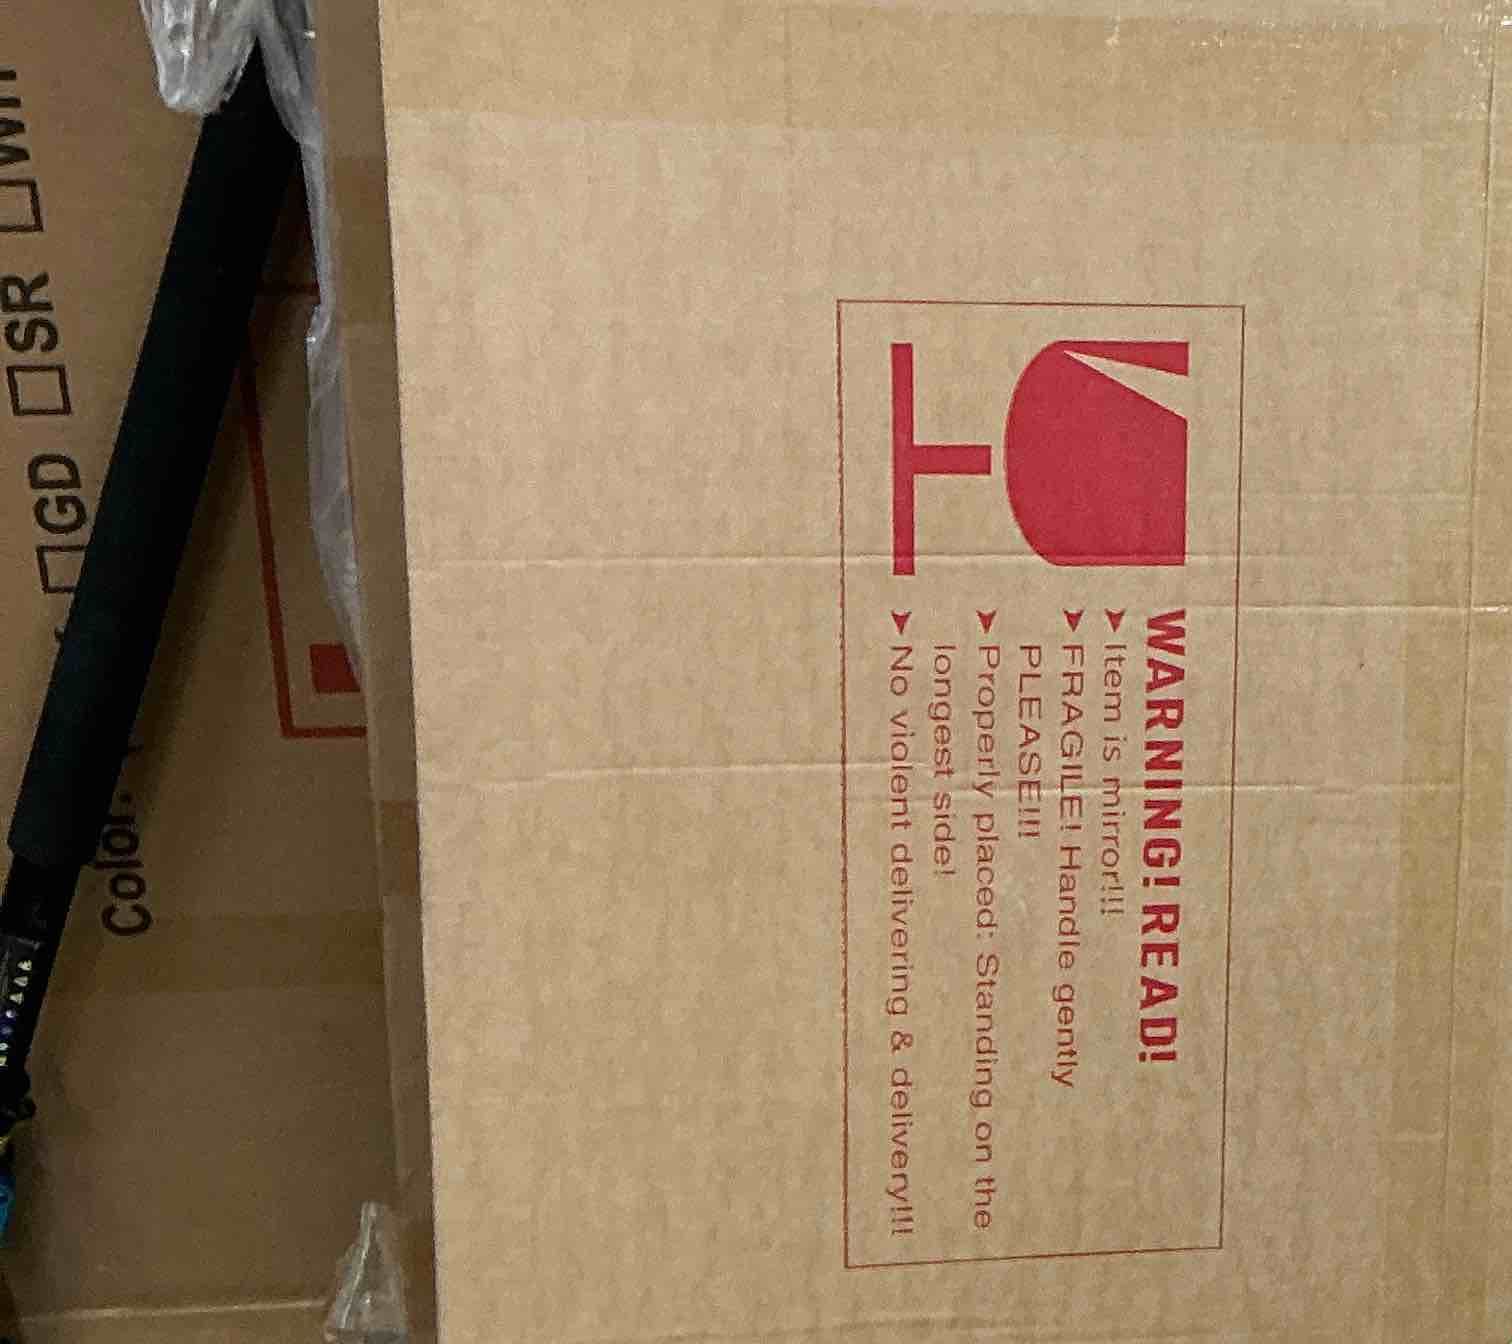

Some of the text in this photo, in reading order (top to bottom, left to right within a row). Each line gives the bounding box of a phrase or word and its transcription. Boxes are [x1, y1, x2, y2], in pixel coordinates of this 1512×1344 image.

[27, 453, 87, 534] GD
[928, 645, 957, 875] longest side!
[1017, 644, 1042, 839] PLEASE!!!
[1051, 644, 1085, 1088] FRAGILE! Handle gently
[1100, 644, 1127, 915] Item is mirror!!!
[886, 645, 915, 1236] No violent delivering & delivery!!!
[969, 645, 1001, 1229] Properly placed: Standing on the
